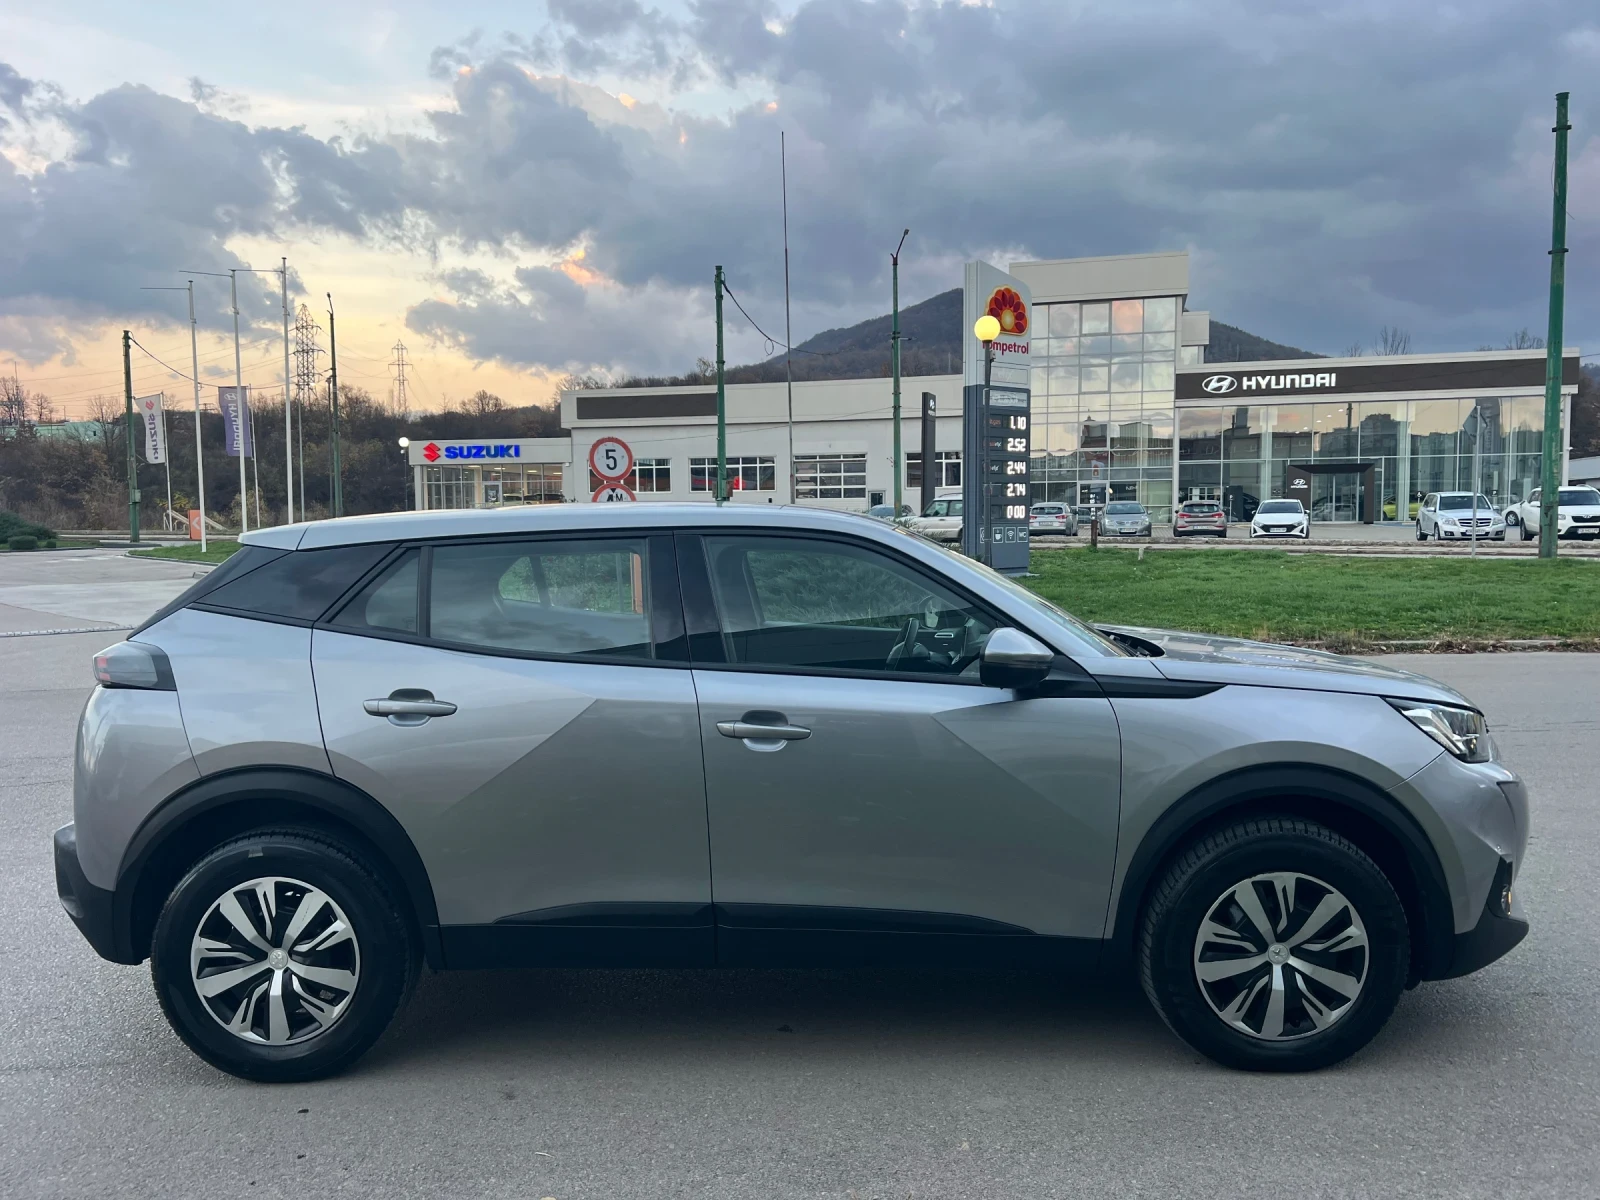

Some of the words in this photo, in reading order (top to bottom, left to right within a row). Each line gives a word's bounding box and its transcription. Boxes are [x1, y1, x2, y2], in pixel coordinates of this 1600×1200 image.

[1242, 373, 1336, 390] HYUNDAI
[444, 444, 520, 459] SUZUKI
[605, 448, 617, 470] 5
